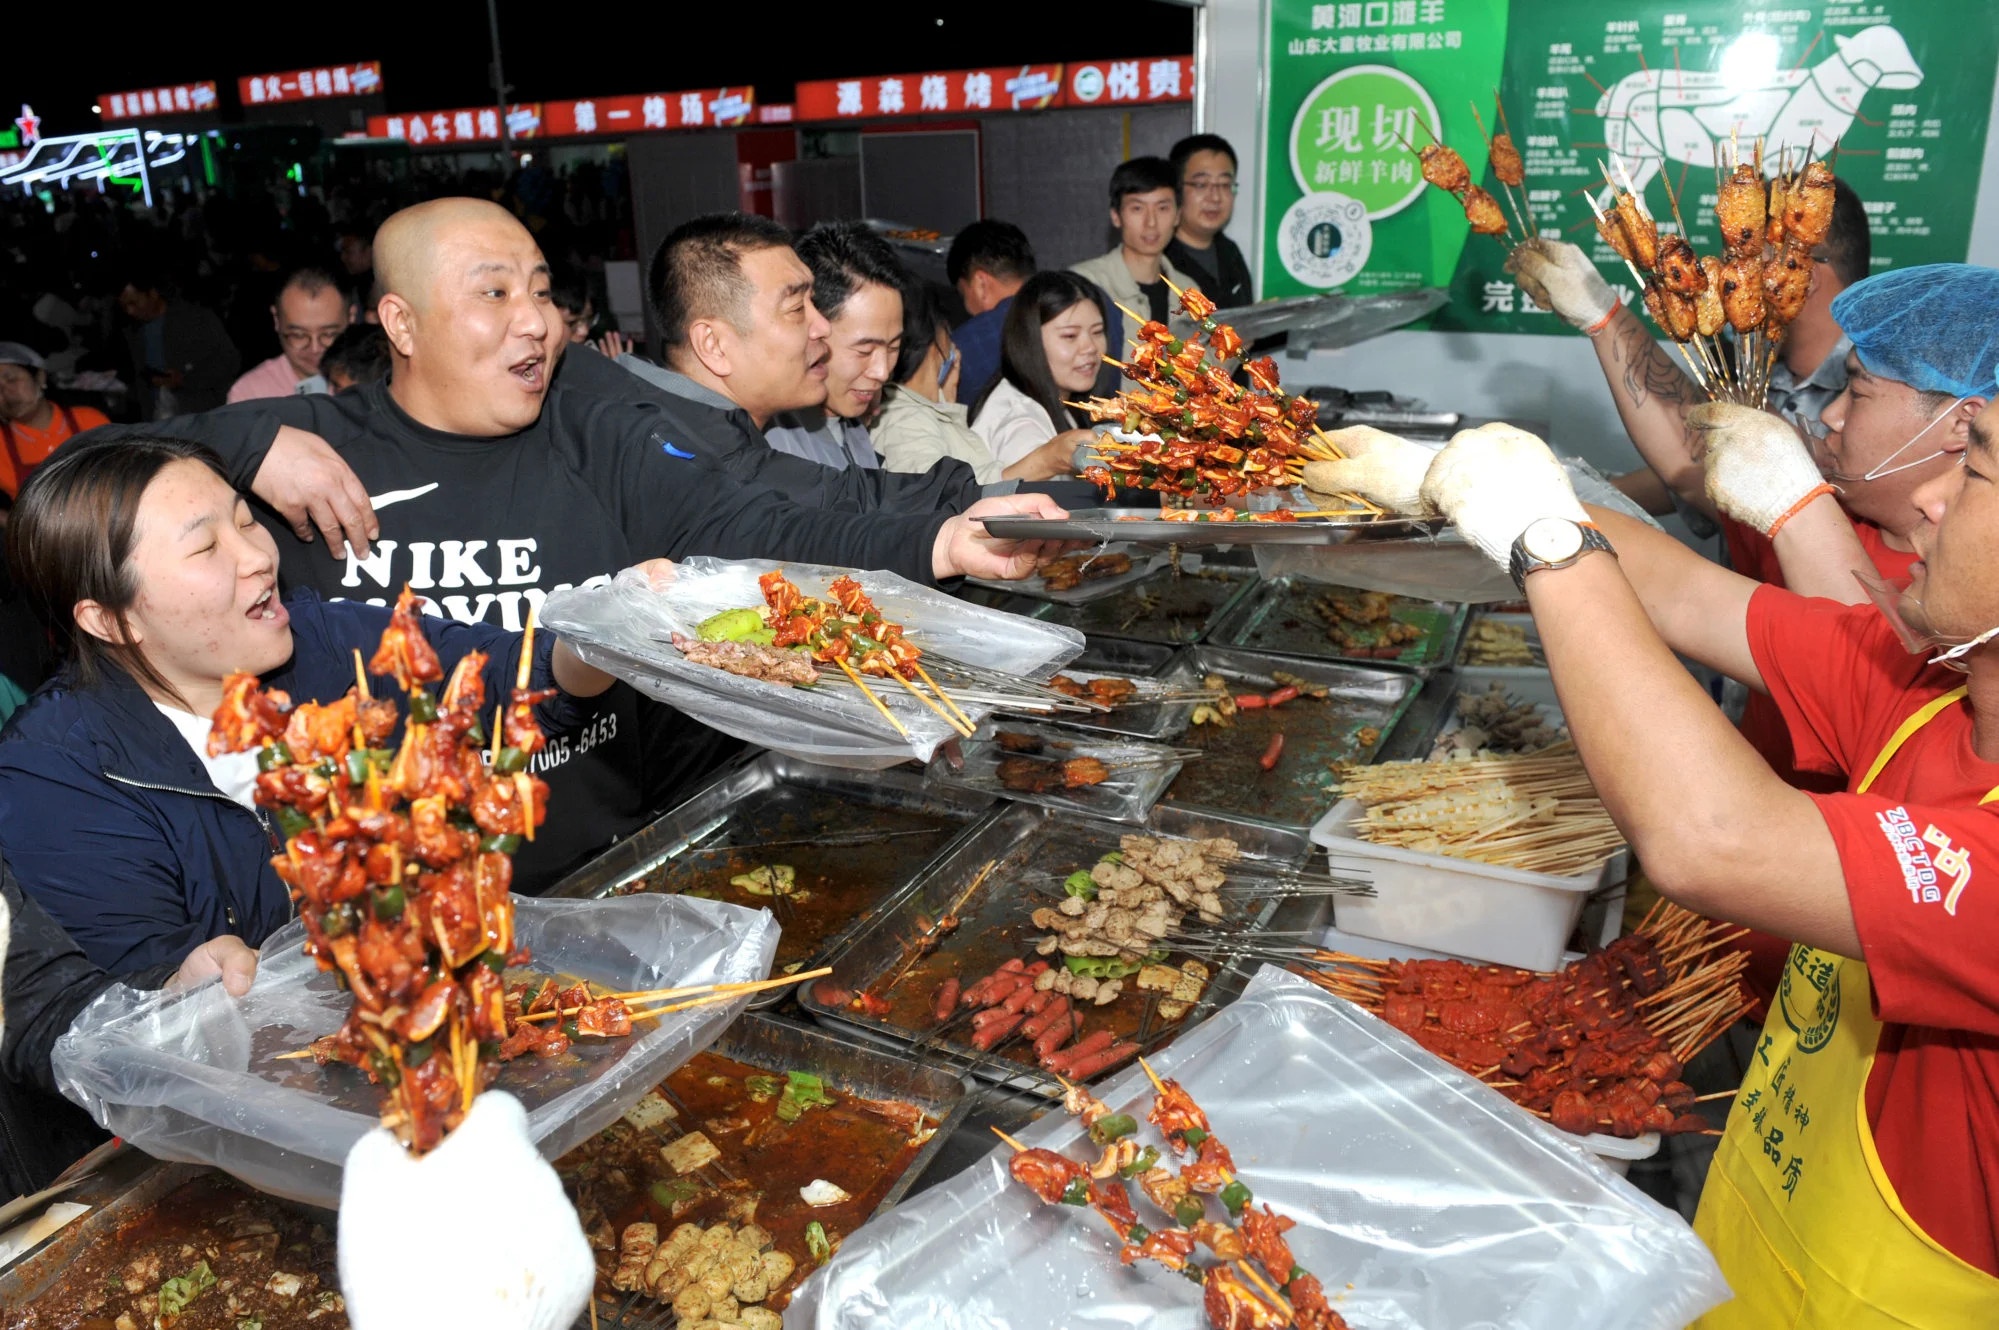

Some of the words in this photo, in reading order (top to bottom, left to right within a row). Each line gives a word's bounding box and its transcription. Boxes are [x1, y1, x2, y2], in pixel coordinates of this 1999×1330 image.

[1107, 59, 1194, 100] 悦贵
[1315, 104, 1419, 153] 现切
[1314, 159, 1413, 185] 新鲜羊肉
[341, 537, 542, 588] NIKE
[1885, 806, 1941, 903] ZBCTDG
